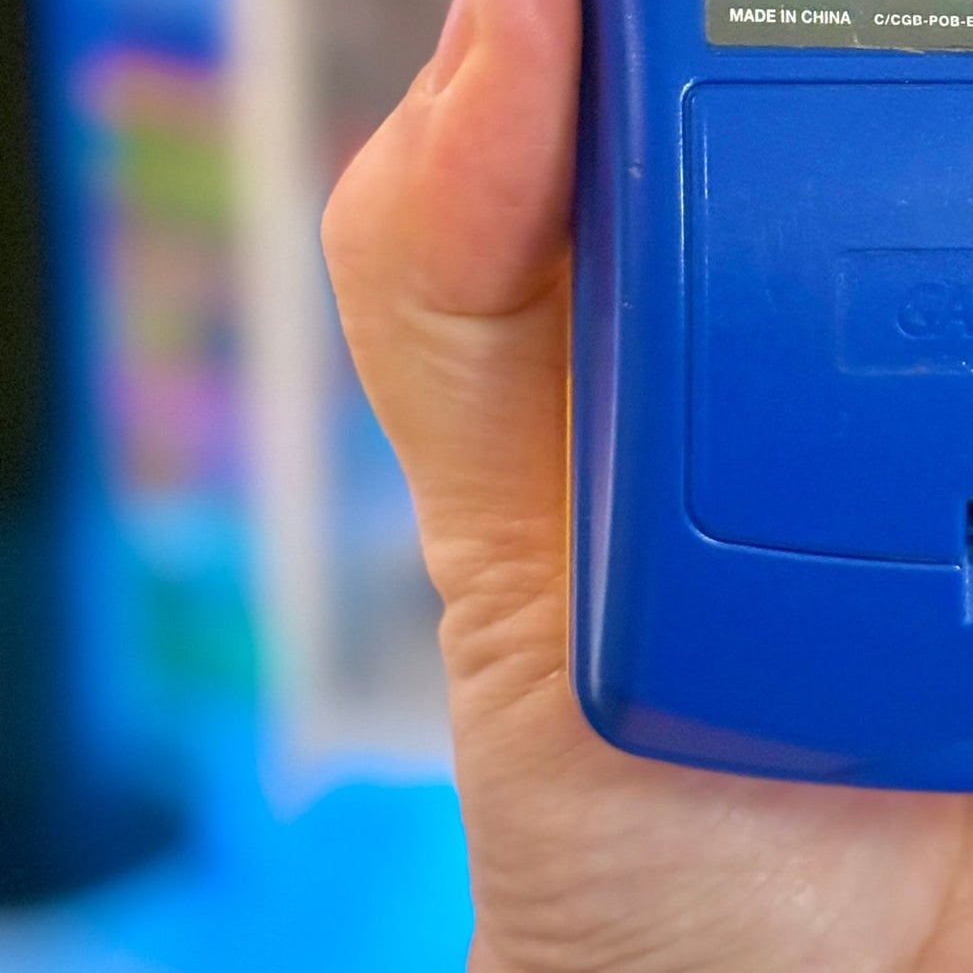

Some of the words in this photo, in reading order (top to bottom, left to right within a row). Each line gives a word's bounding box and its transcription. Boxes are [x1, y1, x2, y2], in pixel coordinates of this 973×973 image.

[729, 8, 777, 23] MADE
[780, 9, 797, 23] IN
[801, 10, 851, 25] CHINA
